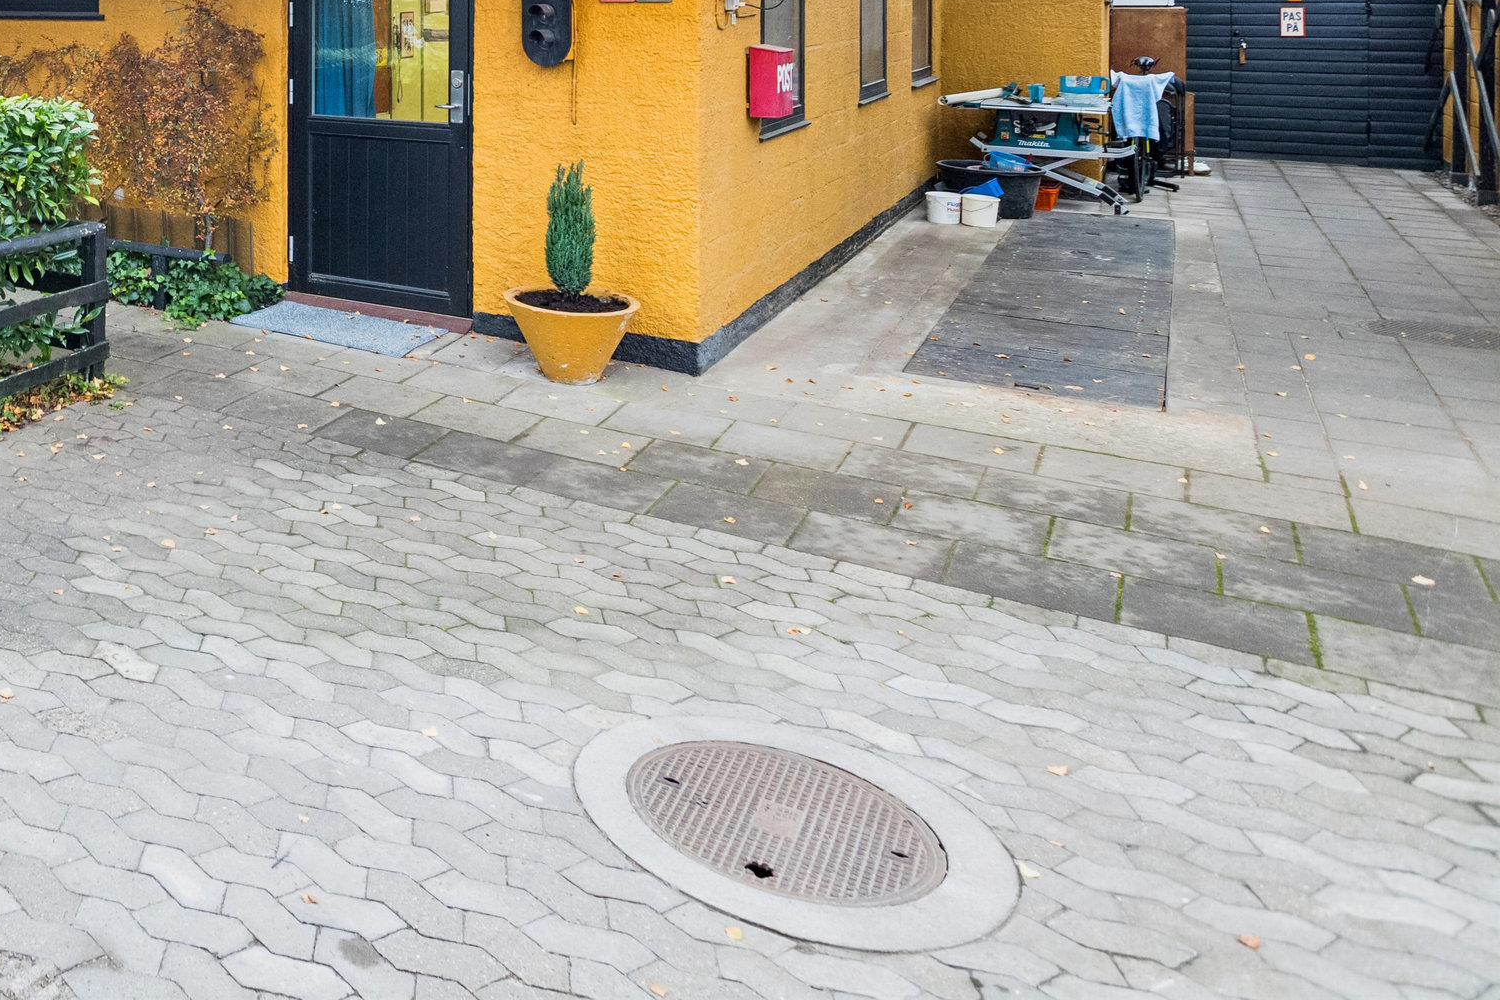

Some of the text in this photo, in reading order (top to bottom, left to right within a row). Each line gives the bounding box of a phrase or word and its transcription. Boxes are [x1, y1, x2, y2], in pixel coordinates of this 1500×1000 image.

[1283, 12, 1302, 21] PAS
[1286, 22, 1299, 32] PÅ
[777, 63, 794, 94] POST
